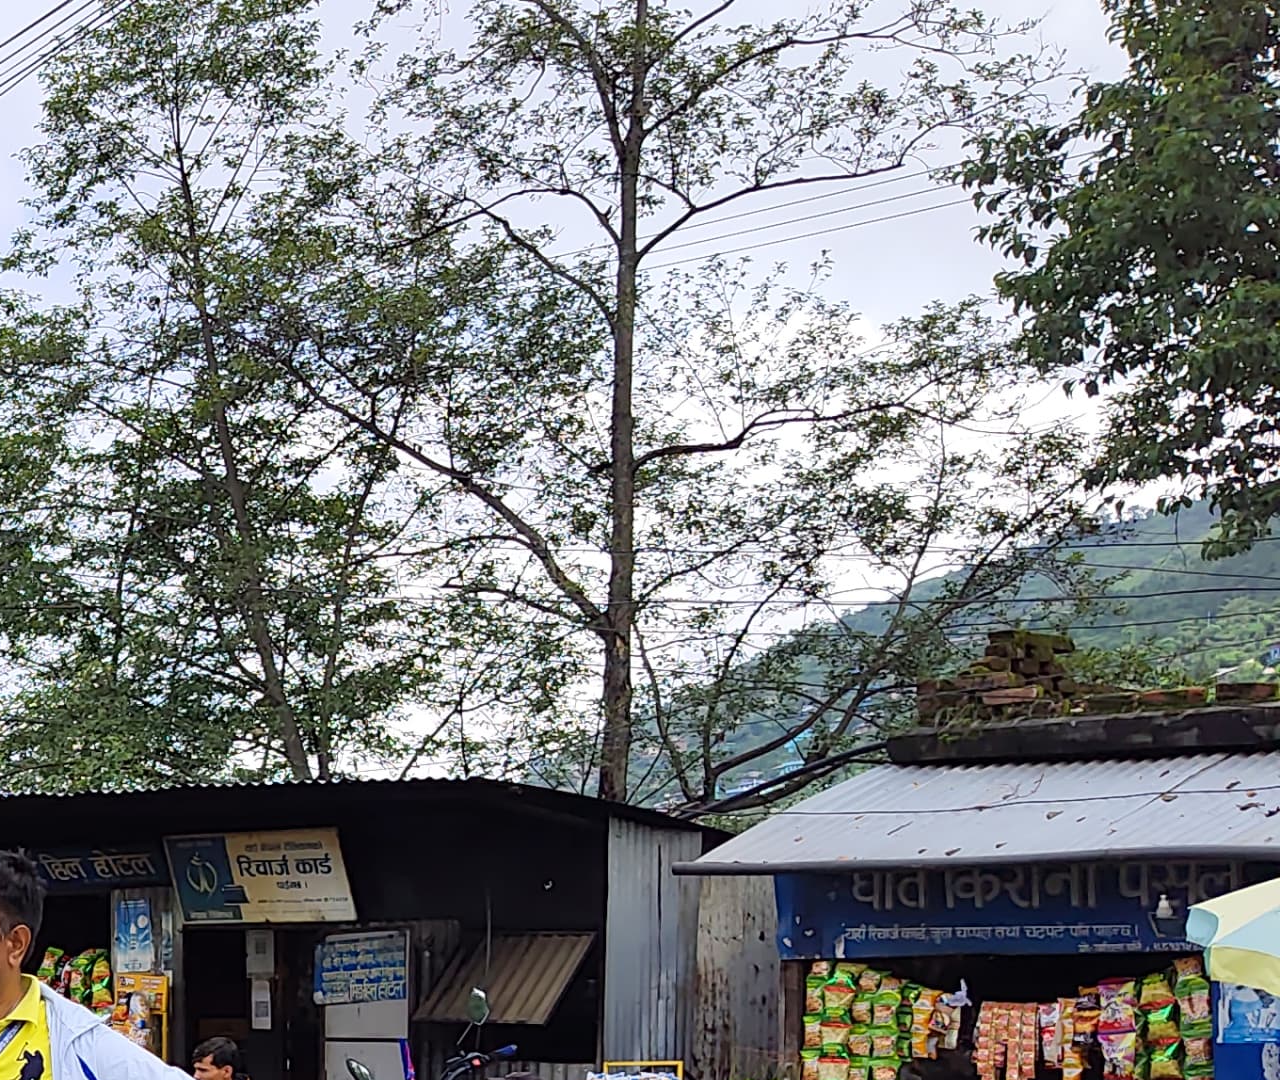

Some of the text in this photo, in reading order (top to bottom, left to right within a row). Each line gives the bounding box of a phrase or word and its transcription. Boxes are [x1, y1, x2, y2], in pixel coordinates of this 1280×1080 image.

[39, 854, 87, 880] हिल
[236, 853, 332, 877] रिचार्ज कार्ड
